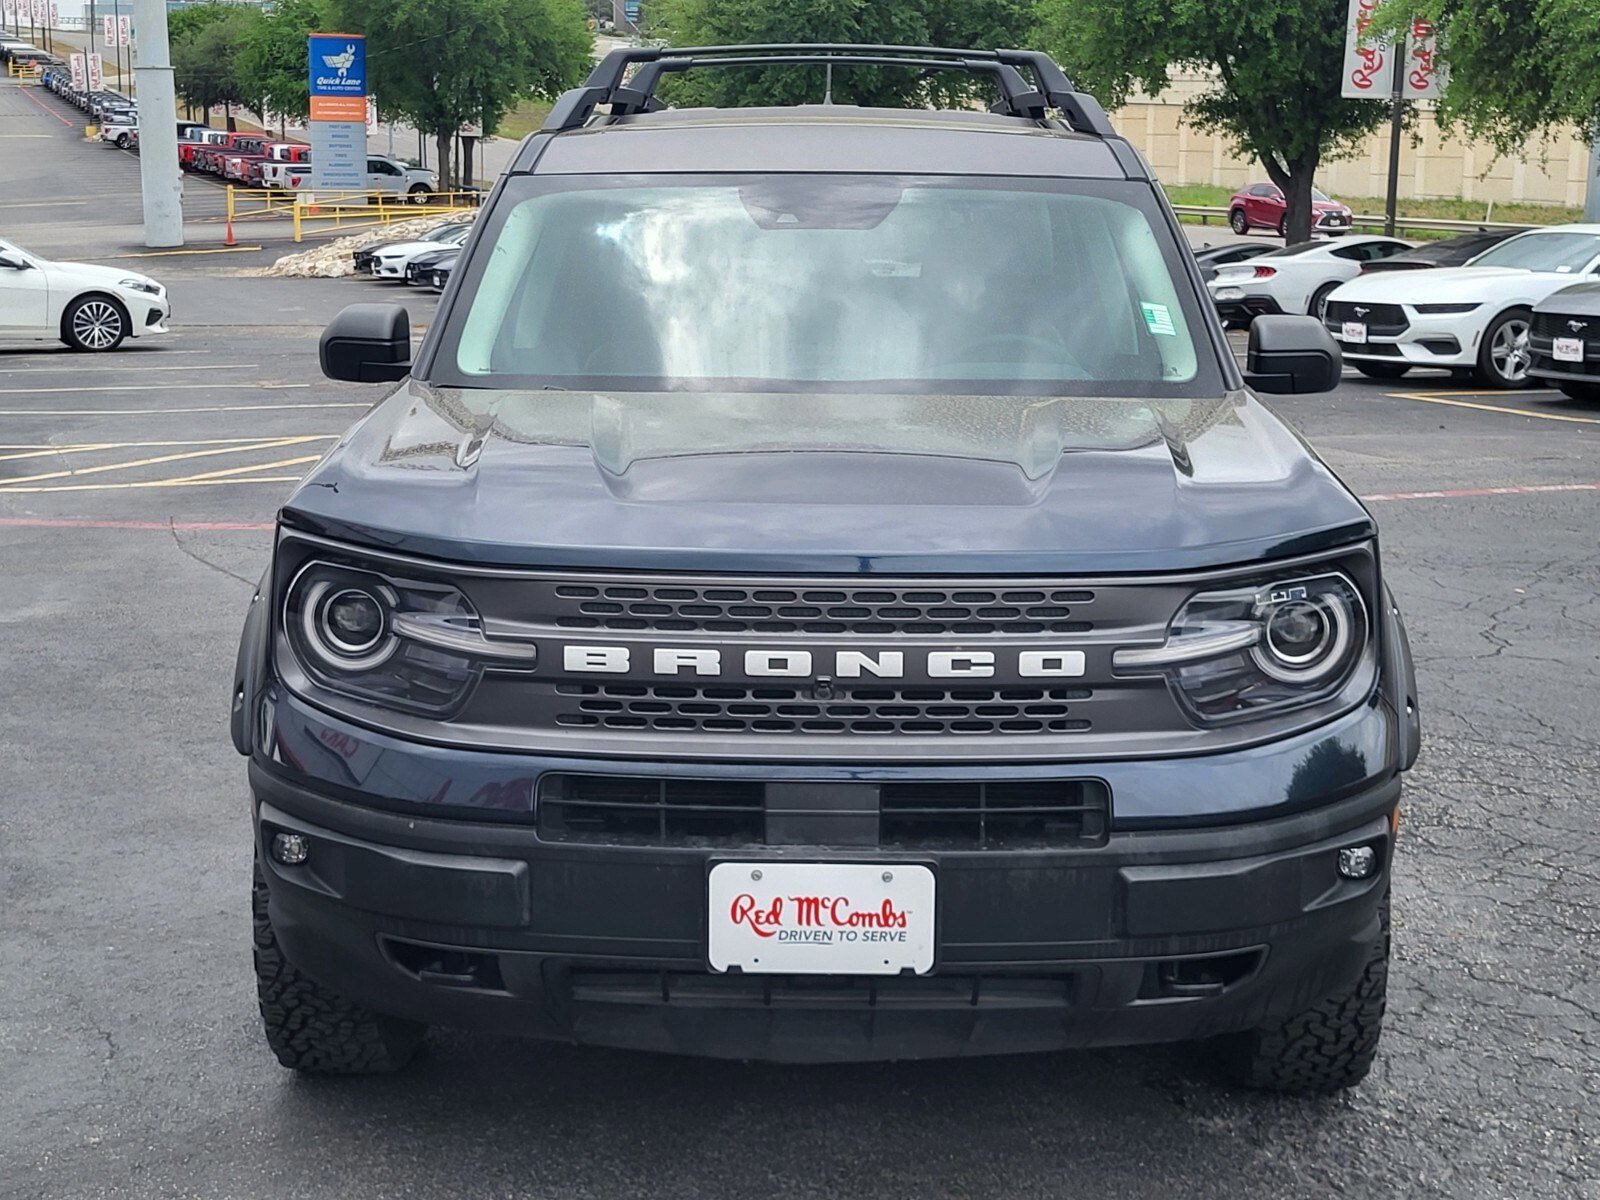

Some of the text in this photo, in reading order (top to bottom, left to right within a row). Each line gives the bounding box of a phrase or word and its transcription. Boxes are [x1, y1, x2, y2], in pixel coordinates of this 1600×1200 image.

[316, 76, 362, 86] Quick Lane
[1351, 48, 1384, 89] Red
[1408, 48, 1433, 90] Red
[562, 645, 1086, 679] BRONCO
[730, 893, 907, 937] Red McCombs
[778, 930, 907, 942] DRIVEN TO SERVE
